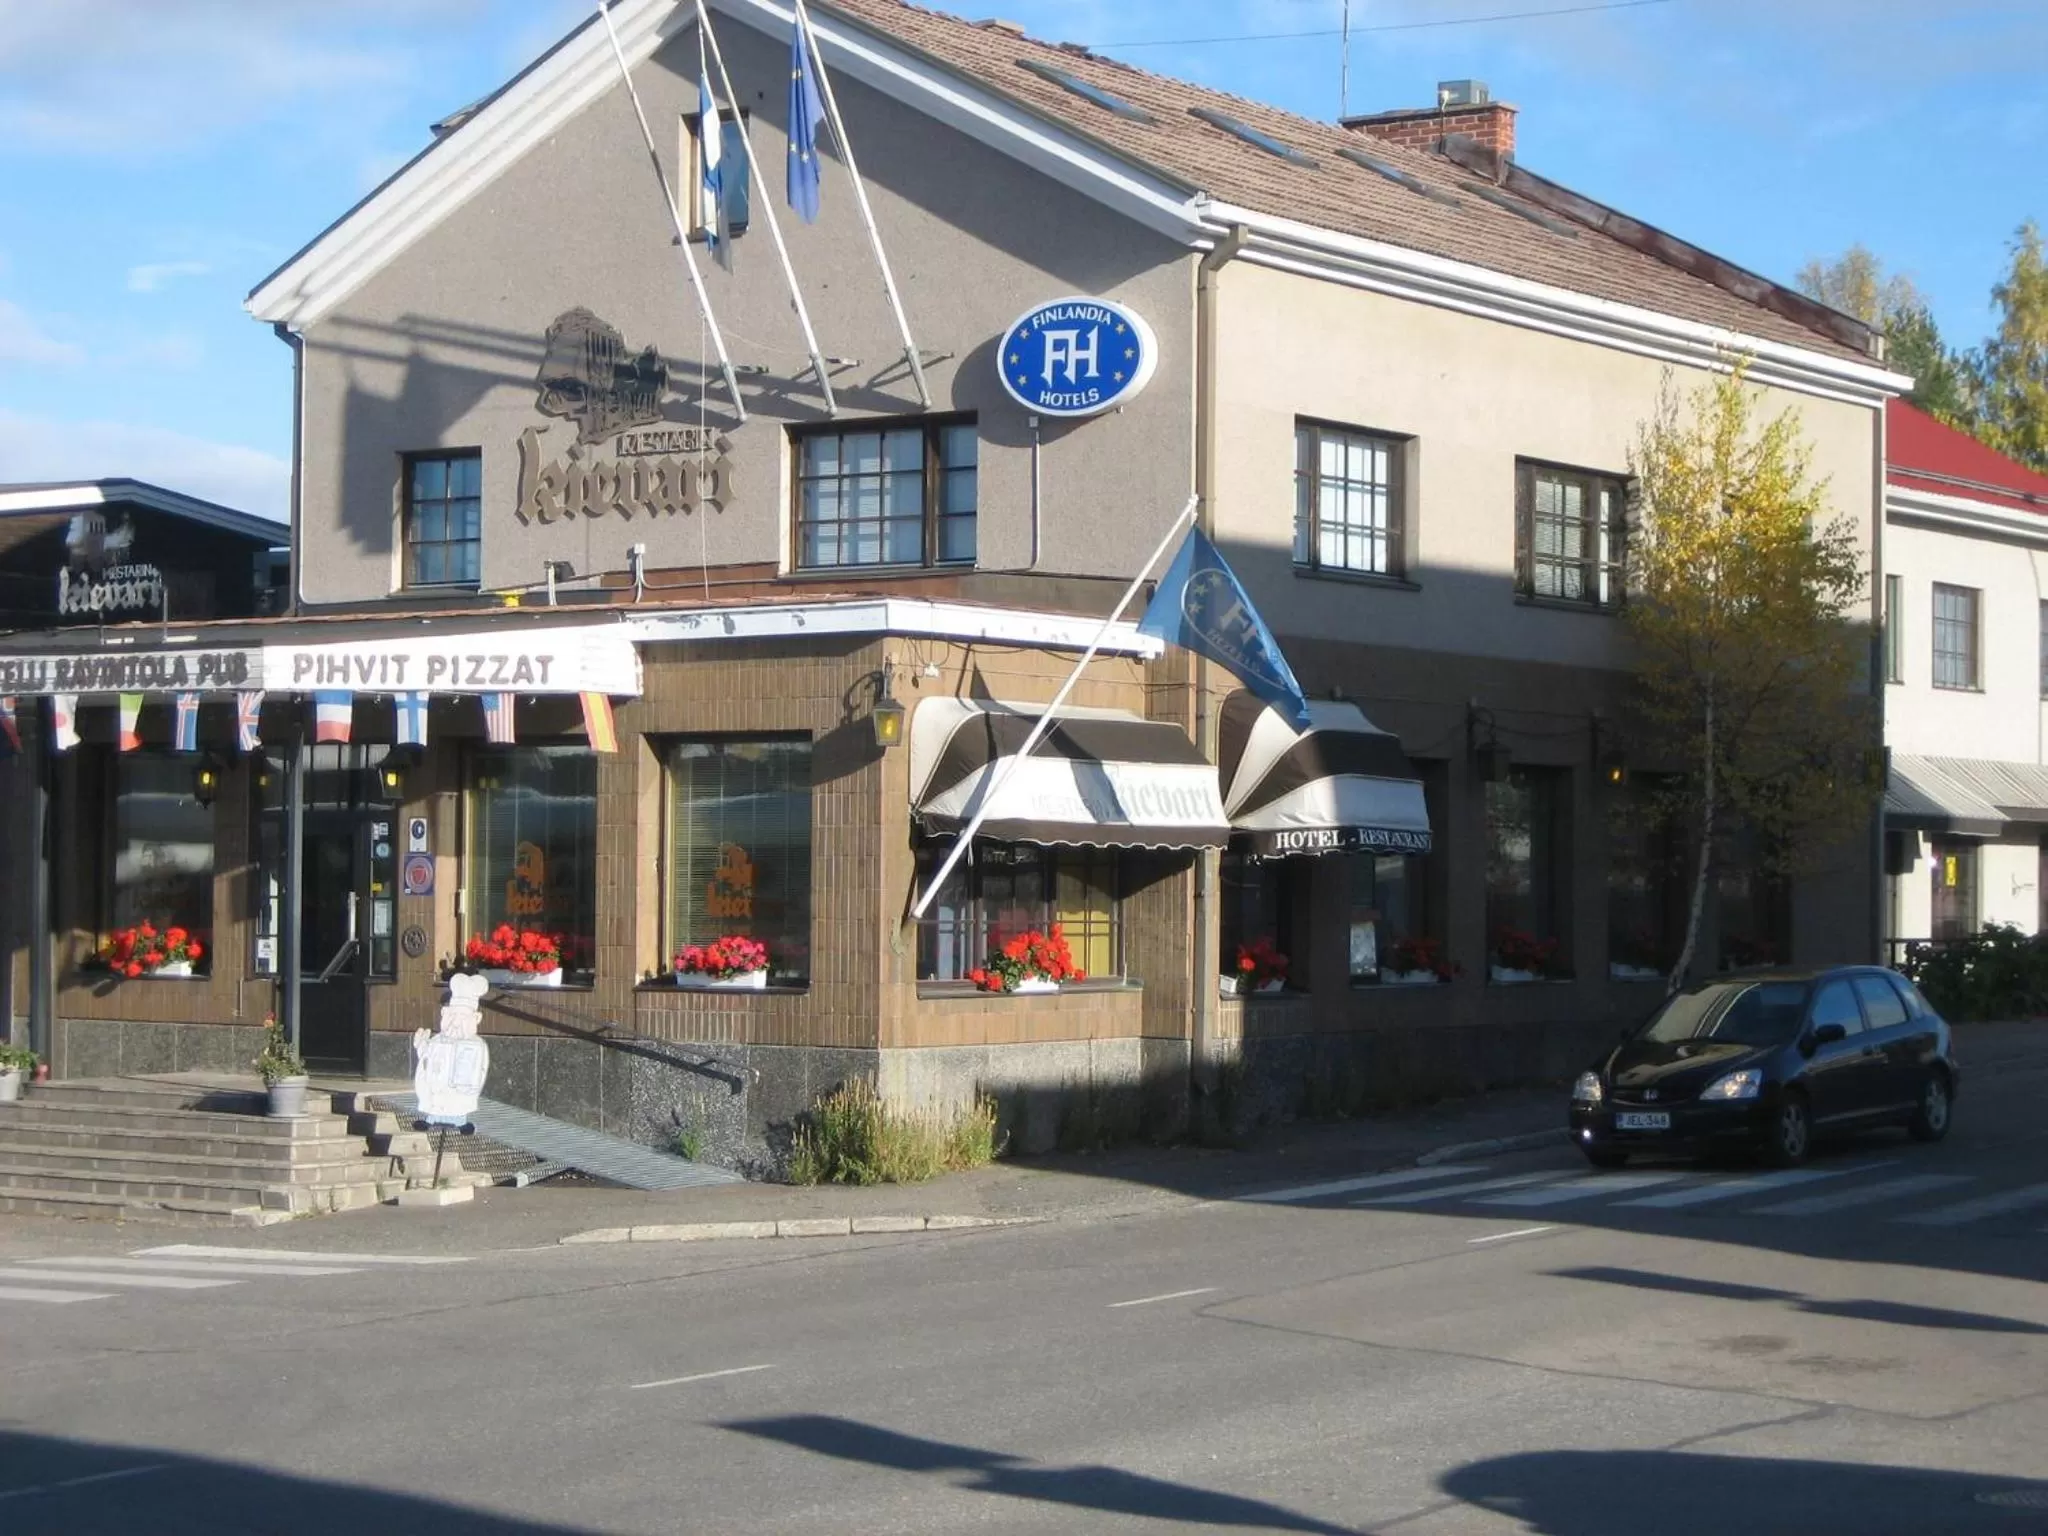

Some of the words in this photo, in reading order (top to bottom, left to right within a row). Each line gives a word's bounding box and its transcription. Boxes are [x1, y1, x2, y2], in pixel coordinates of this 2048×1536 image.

[1032, 305, 1111, 329] FINLANDIA
[1040, 325, 1100, 389] FH
[1039, 387, 1100, 406] HOTELS
[54, 656, 188, 689] RAVINTOLA
[197, 651, 248, 686] PUB
[293, 653, 410, 684] PIHVIT
[427, 654, 554, 685] PIZZAT
[1276, 829, 1345, 850] HOTEL
